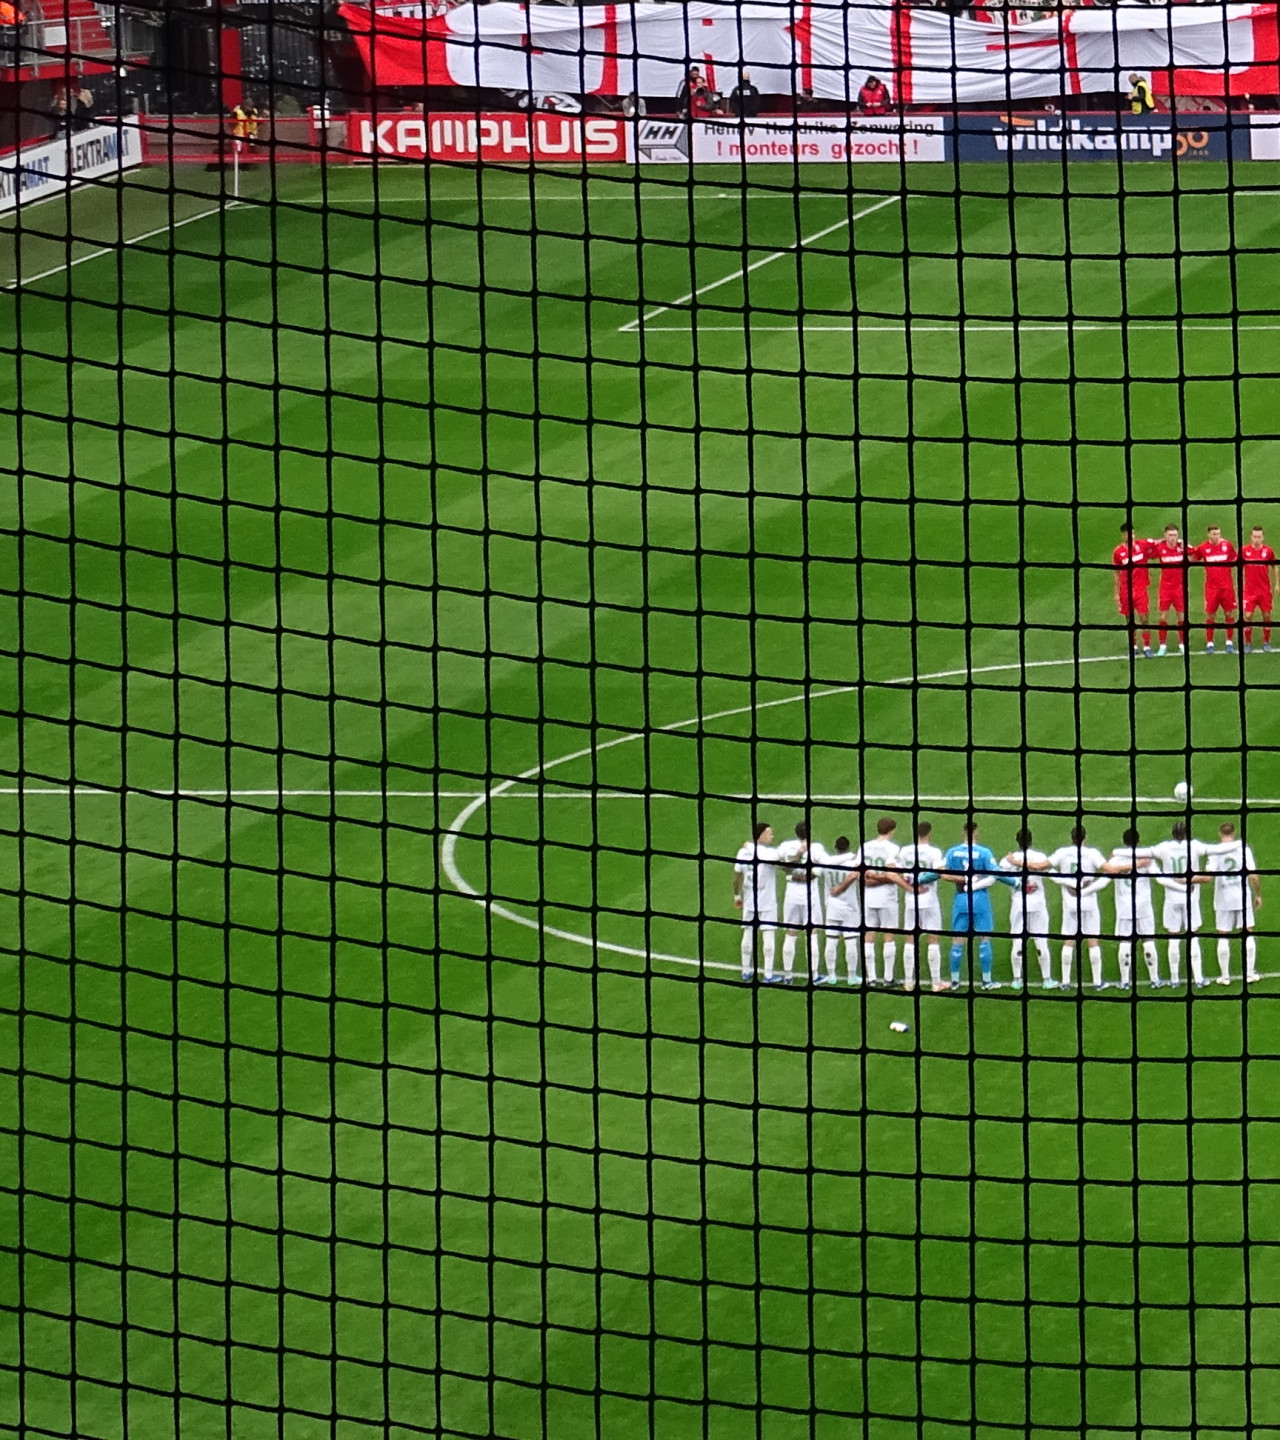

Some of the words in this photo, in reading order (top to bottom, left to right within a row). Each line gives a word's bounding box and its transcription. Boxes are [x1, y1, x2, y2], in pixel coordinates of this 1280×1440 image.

[66, 129, 129, 174] LEKTRAMT
[360, 119, 619, 154] KAMPHUIS
[729, 141, 819, 155] monteurs
